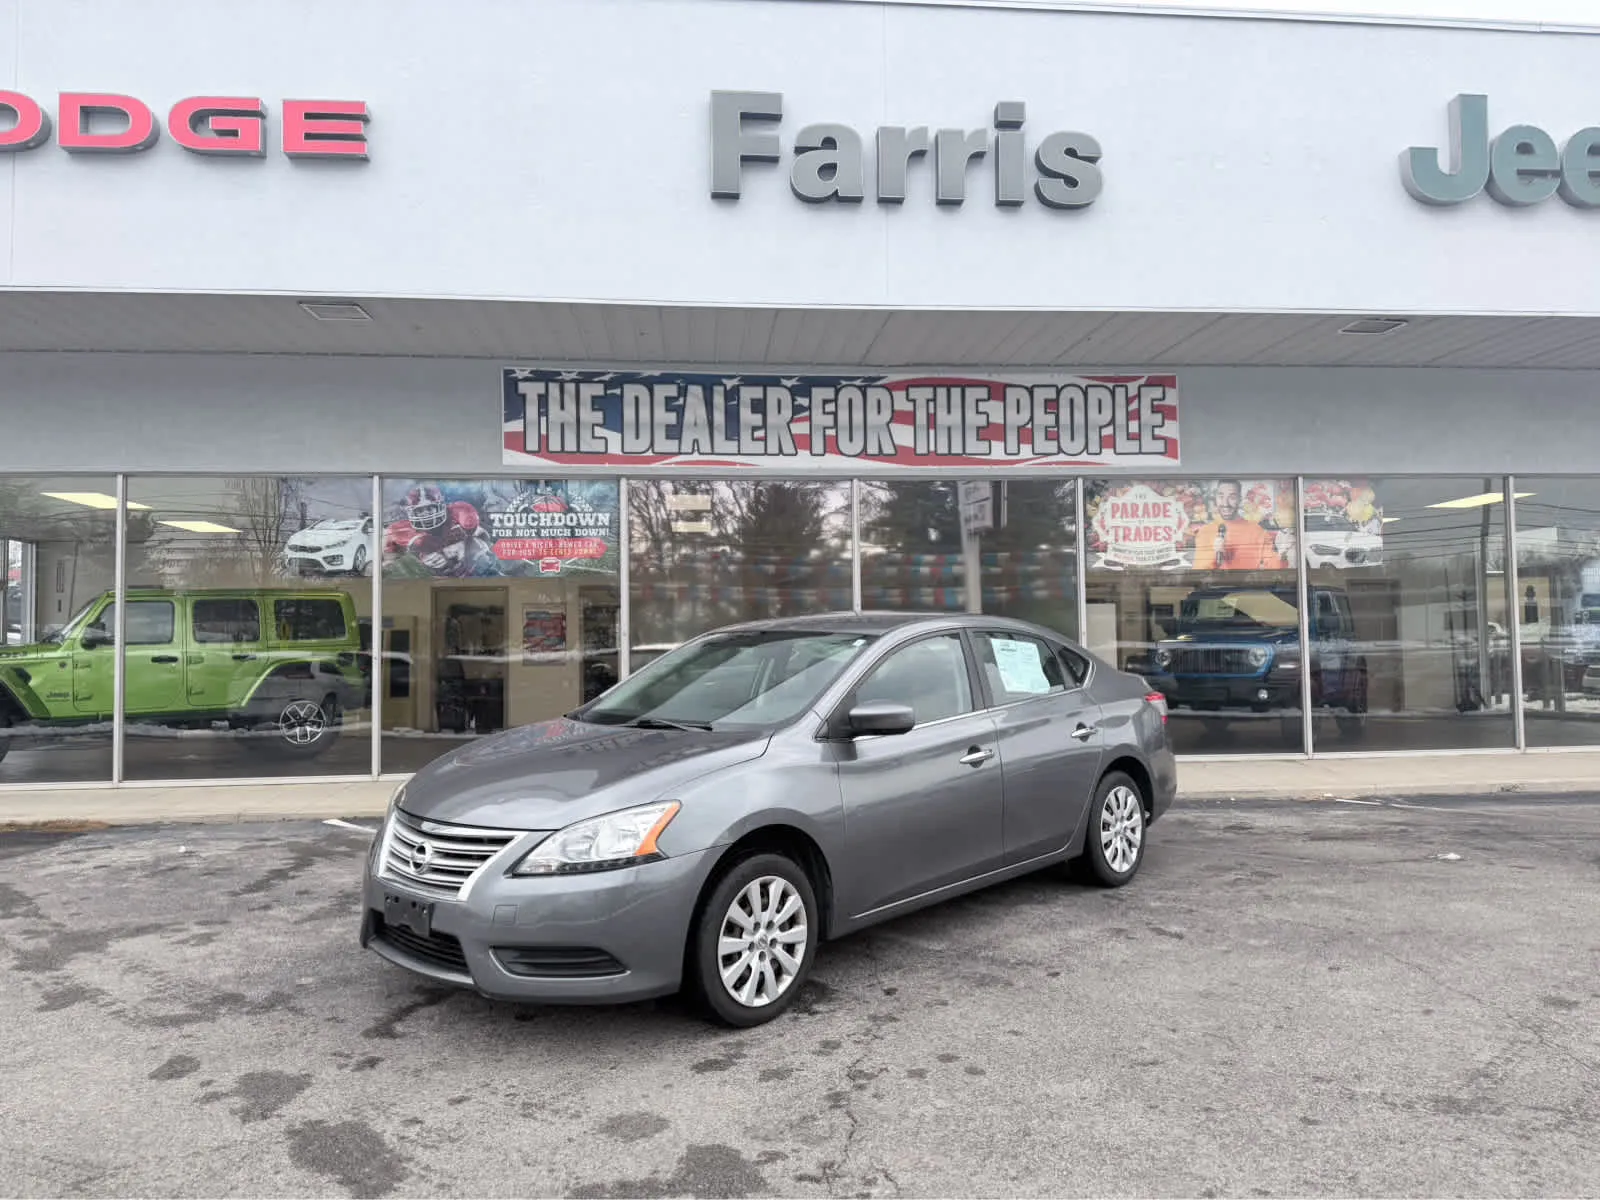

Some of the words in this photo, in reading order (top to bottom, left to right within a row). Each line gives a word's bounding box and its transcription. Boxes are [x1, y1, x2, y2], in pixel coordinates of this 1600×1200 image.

[710, 89, 1103, 208] Farris
[517, 381, 608, 453] THE
[620, 383, 798, 456] DEALER
[809, 384, 897, 457] FOR
[907, 384, 991, 456] THE
[1004, 384, 1168, 456] PEOPLE
[1111, 502, 1172, 519] PARADE
[490, 512, 611, 527] TOUCHDOWN
[492, 528, 513, 537] FOR
[516, 528, 537, 537] NOT
[540, 528, 571, 537] MUCH
[575, 528, 609, 537] DOWN!
[1111, 525, 1173, 543] TRADES
